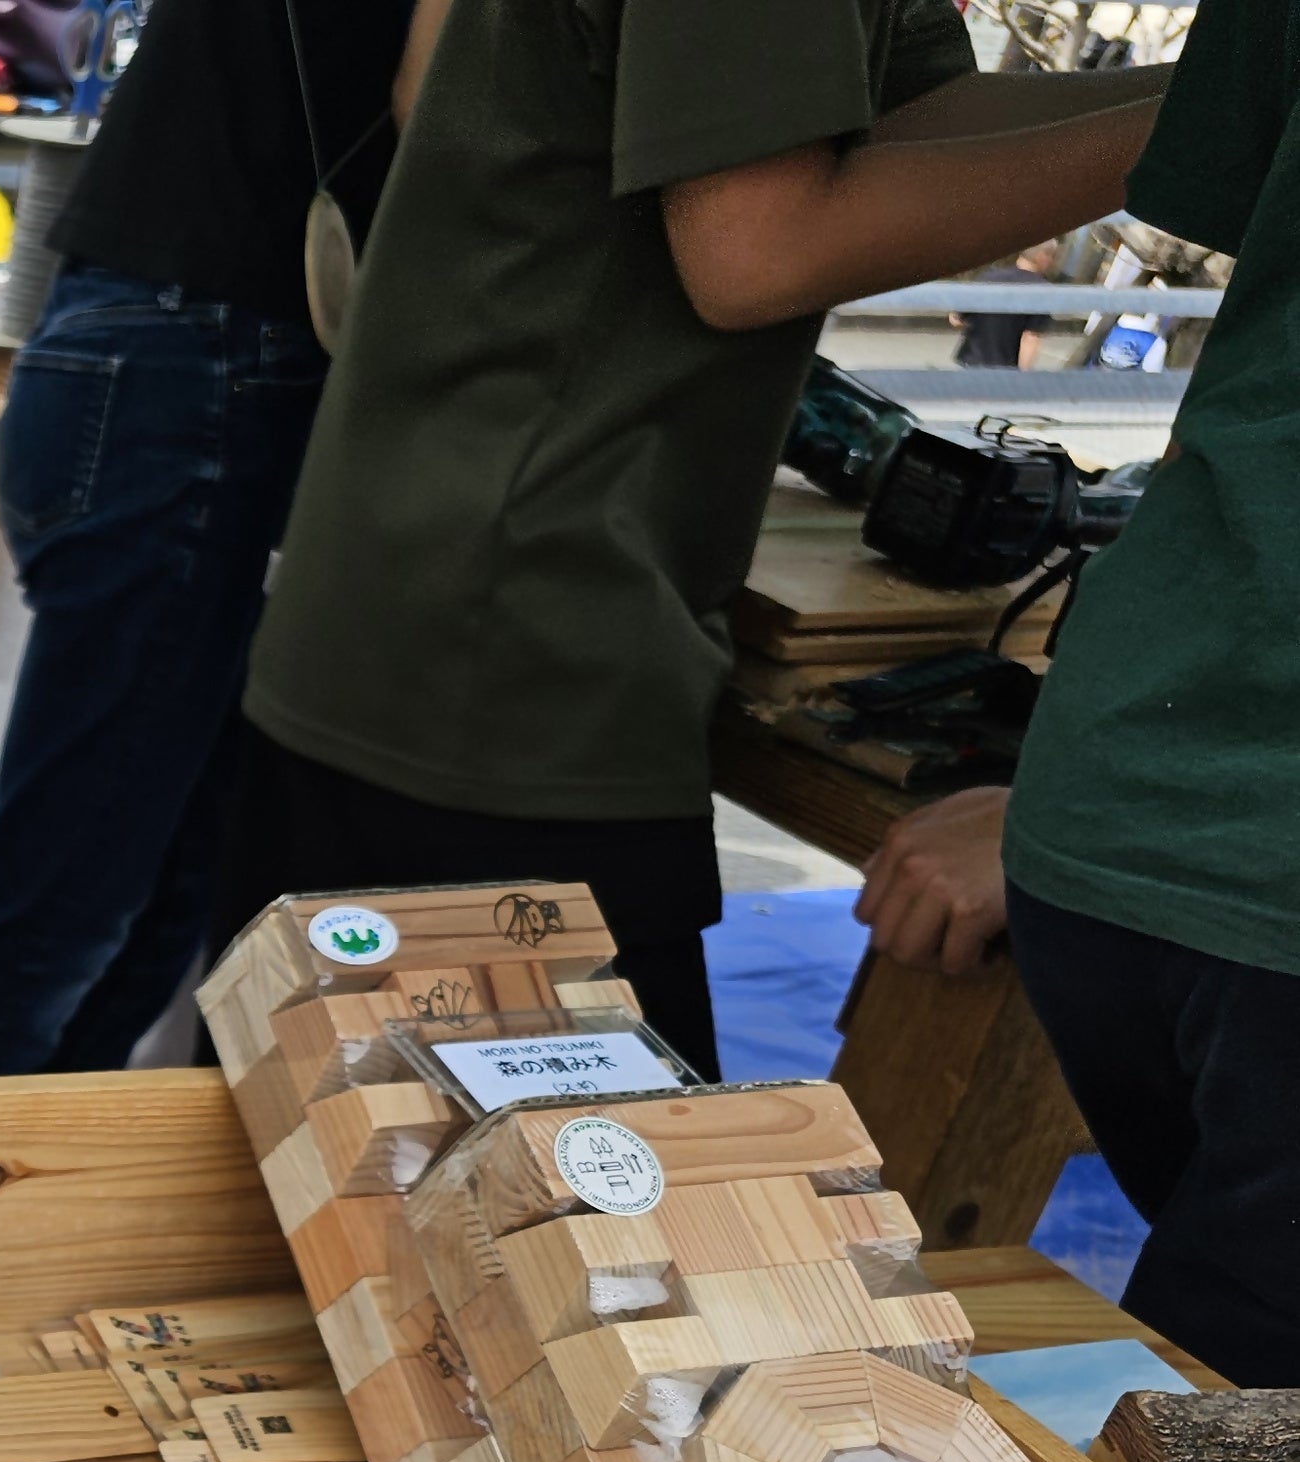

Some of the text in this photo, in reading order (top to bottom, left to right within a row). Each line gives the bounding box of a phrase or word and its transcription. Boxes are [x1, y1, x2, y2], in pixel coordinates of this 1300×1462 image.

[492, 1053, 618, 1078] 森の積み木
